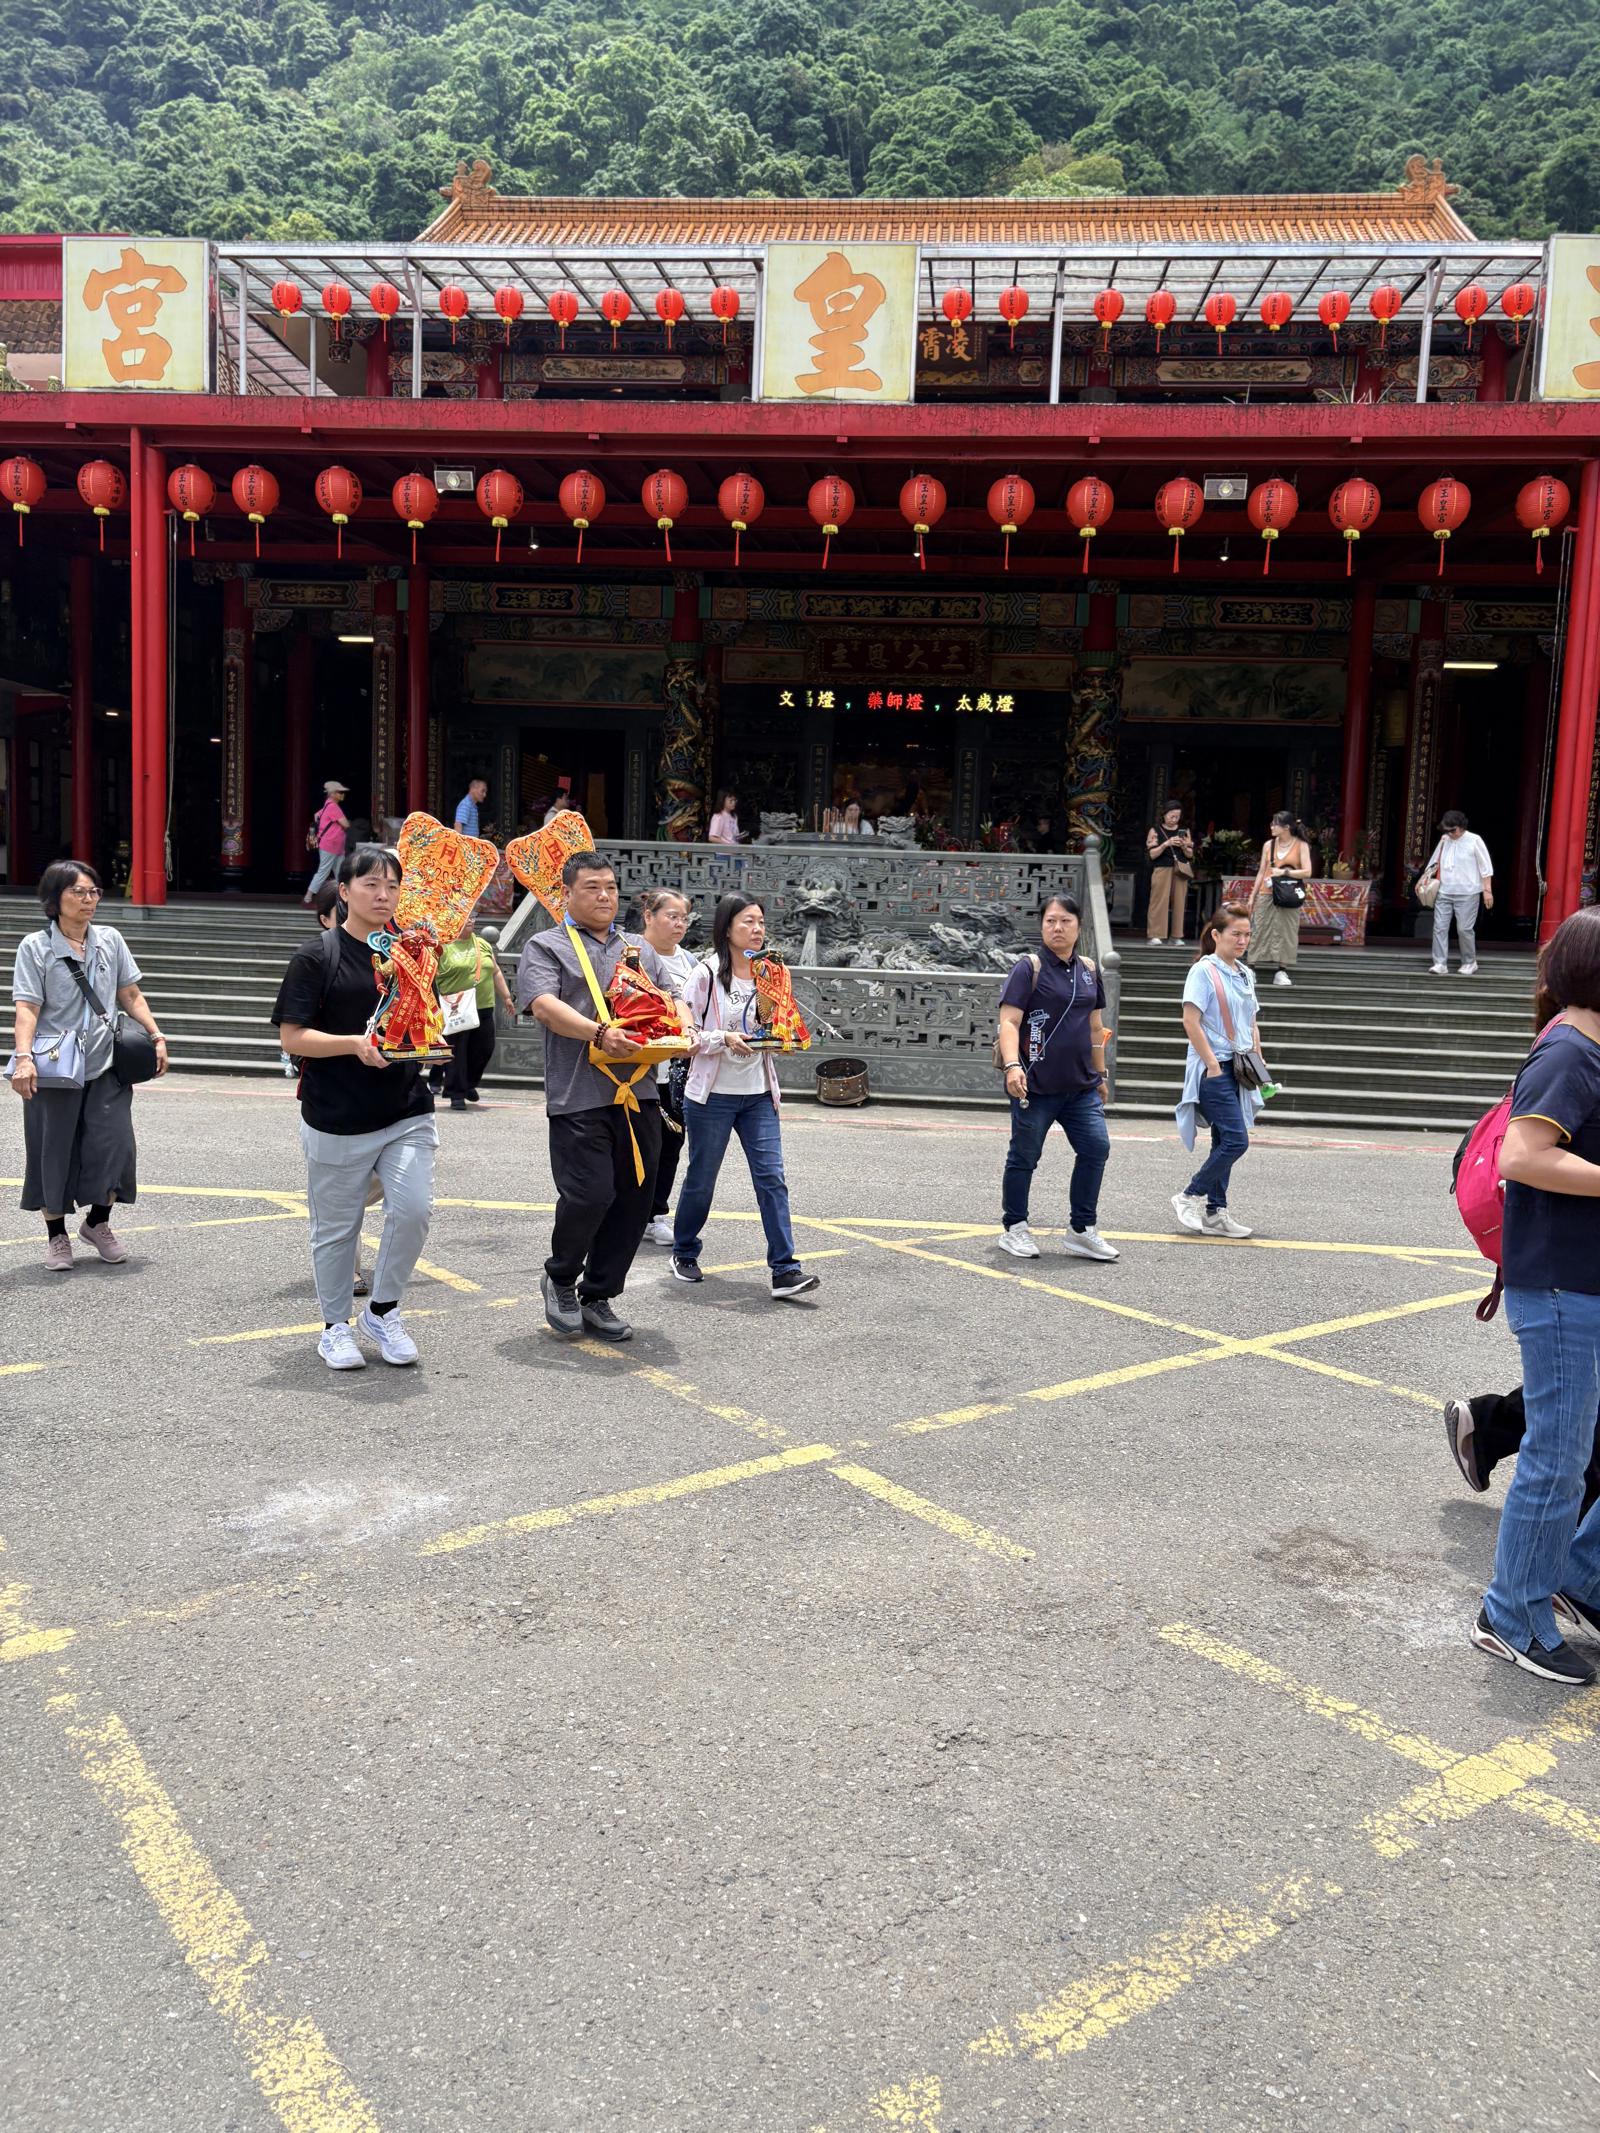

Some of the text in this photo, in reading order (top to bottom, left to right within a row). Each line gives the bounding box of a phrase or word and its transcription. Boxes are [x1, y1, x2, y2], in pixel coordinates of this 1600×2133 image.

[82, 247, 188, 382] 宮
[794, 252, 886, 393] 皇
[178, 473, 188, 506] 玉皇宮
[248, 473, 256, 508] 玉皇宮
[403, 481, 413, 515] 玉皇宮
[484, 478, 494, 512] 玉皇宮
[579, 479, 589, 513] 玉皇宮
[655, 479, 665, 512] 玉皇宮
[739, 482, 750, 516] 玉皇宮
[830, 484, 841, 519] 玉皇宮
[918, 484, 929, 518] 玉皇宮
[1005, 484, 1016, 519] 玉皇宮
[1087, 486, 1099, 521] 玉皇宮
[1182, 489, 1196, 522] 玉皇宮
[1264, 489, 1274, 523] 玉皇宮
[1361, 488, 1376, 524] 玉皇宮
[1437, 488, 1449, 524] 玉皇宮
[1542, 485, 1555, 521] 玉皇宮
[956, 692, 1015, 713] 太歲燈
